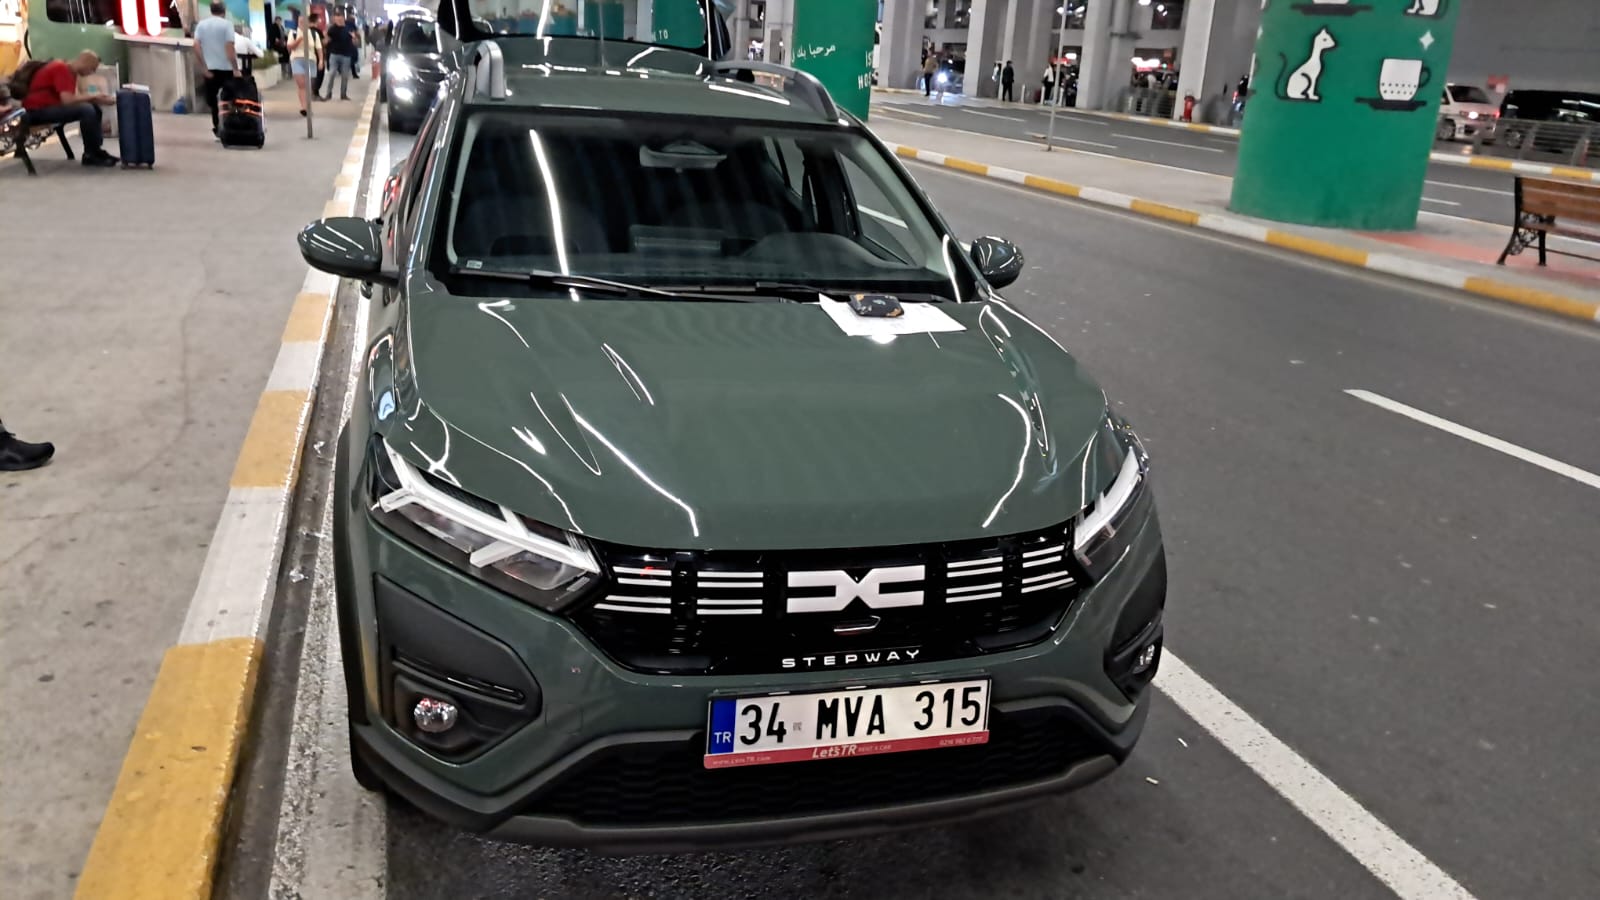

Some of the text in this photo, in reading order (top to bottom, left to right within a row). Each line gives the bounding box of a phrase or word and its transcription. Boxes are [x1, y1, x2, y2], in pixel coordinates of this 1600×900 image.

[809, 44, 836, 58] مرحبا
[782, 649, 919, 668] STEPWAY
[740, 686, 982, 745] 34 MVA 315
[714, 731, 732, 743] TR
